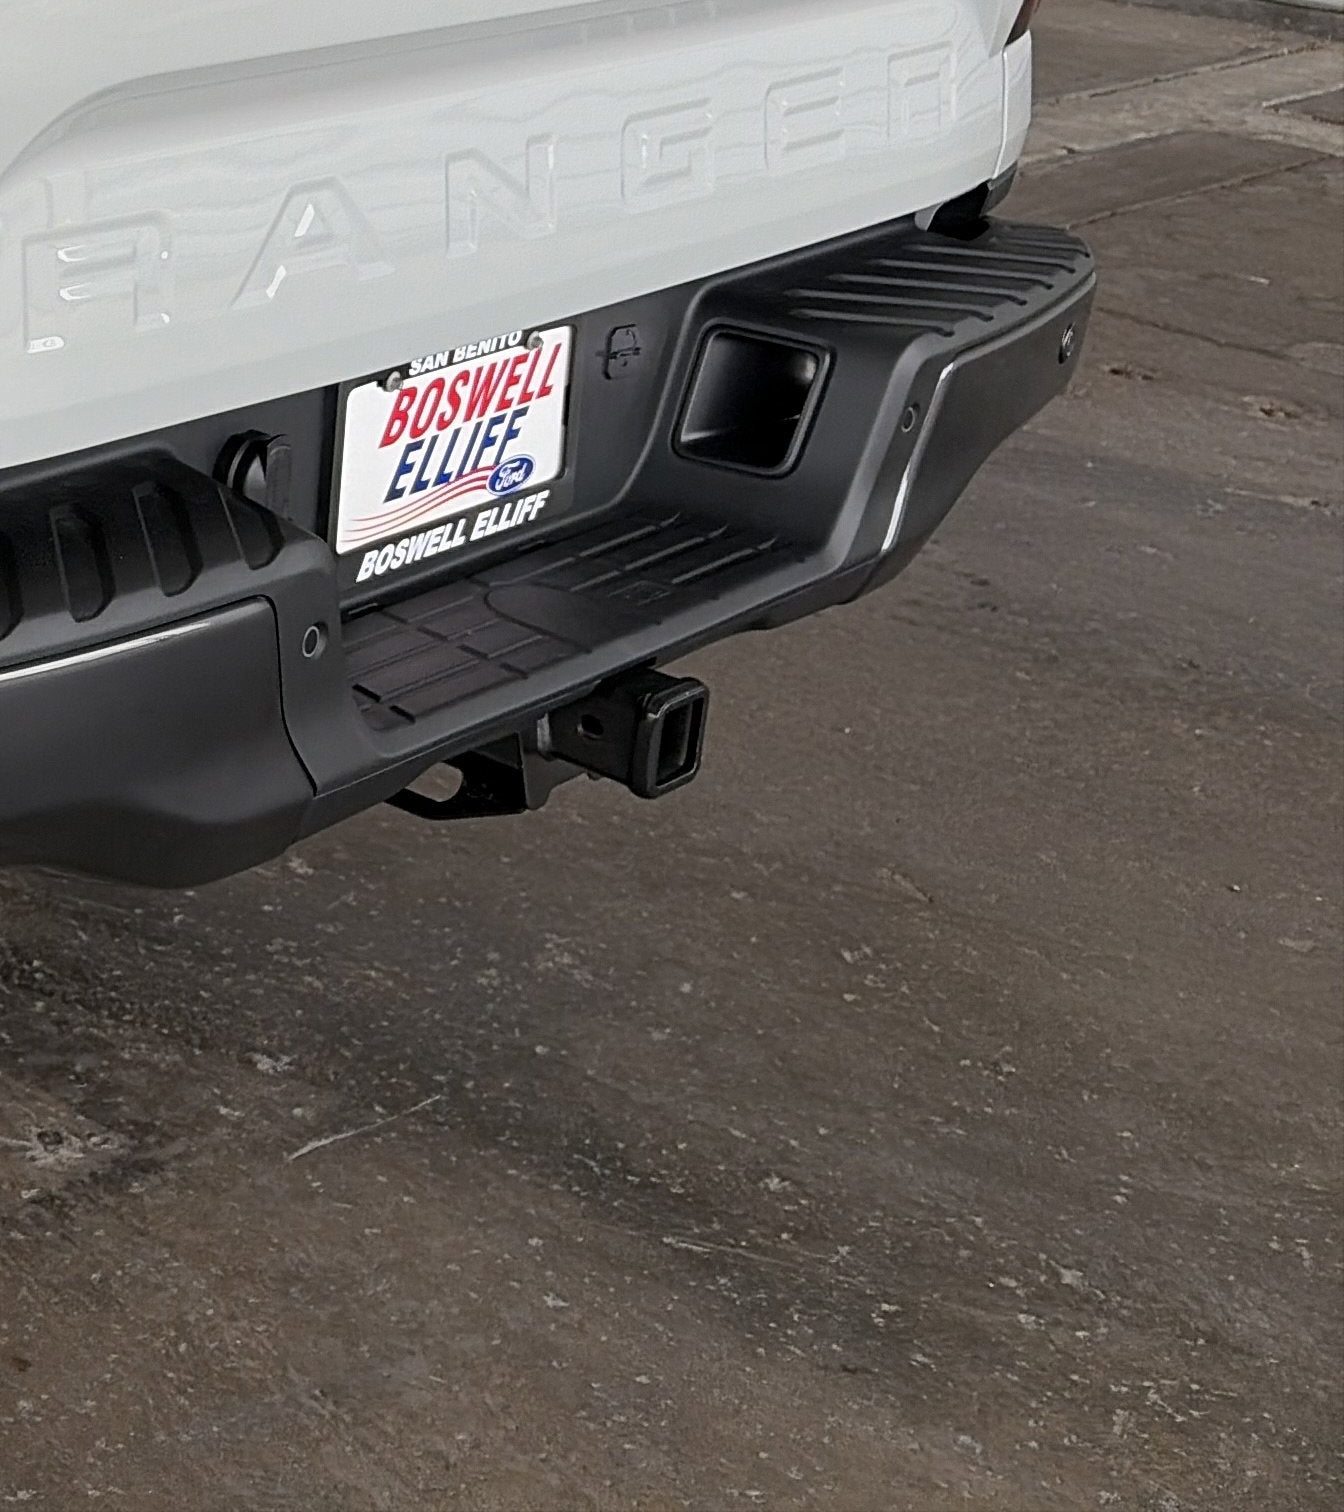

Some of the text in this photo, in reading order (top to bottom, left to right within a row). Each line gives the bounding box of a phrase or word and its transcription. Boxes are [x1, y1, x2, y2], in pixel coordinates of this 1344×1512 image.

[21, 39, 959, 354] RANGER
[378, 342, 562, 449] BOSWELL
[408, 330, 522, 376] SAN BENITO
[383, 405, 530, 503] ELLIFF
[355, 489, 550, 583] BOSWELL ELLIFF
